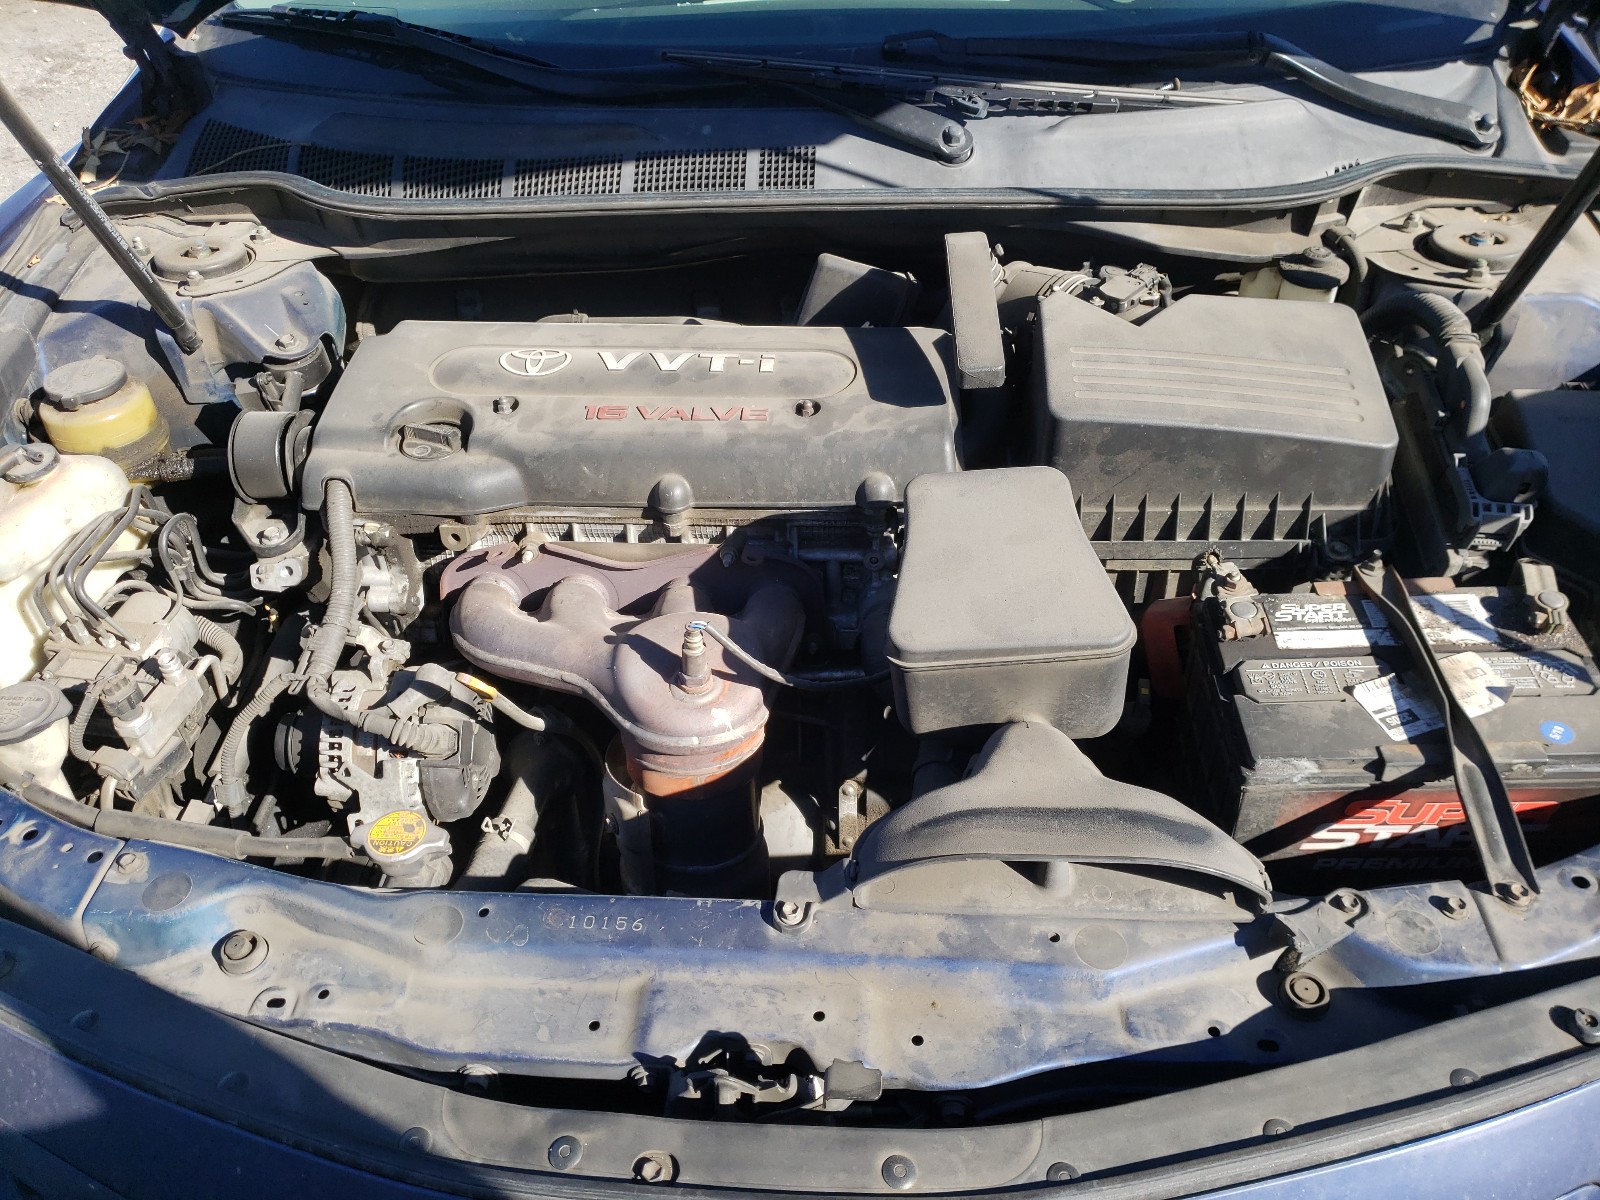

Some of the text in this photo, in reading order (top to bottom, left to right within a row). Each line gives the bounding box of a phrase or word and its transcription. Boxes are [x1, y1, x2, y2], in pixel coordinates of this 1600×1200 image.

[597, 351, 776, 372] VVT-i
[584, 405, 769, 422] 16 VALVE
[1274, 610, 1350, 622] START
[1280, 602, 1347, 613] SUPER
[1271, 661, 1314, 669] DANGER
[1322, 659, 1362, 667] POISON
[1344, 799, 1560, 825] SUPR
[372, 839, 413, 848] CAUTION
[1299, 822, 1551, 850] STAR
[568, 915, 645, 932] 10156
